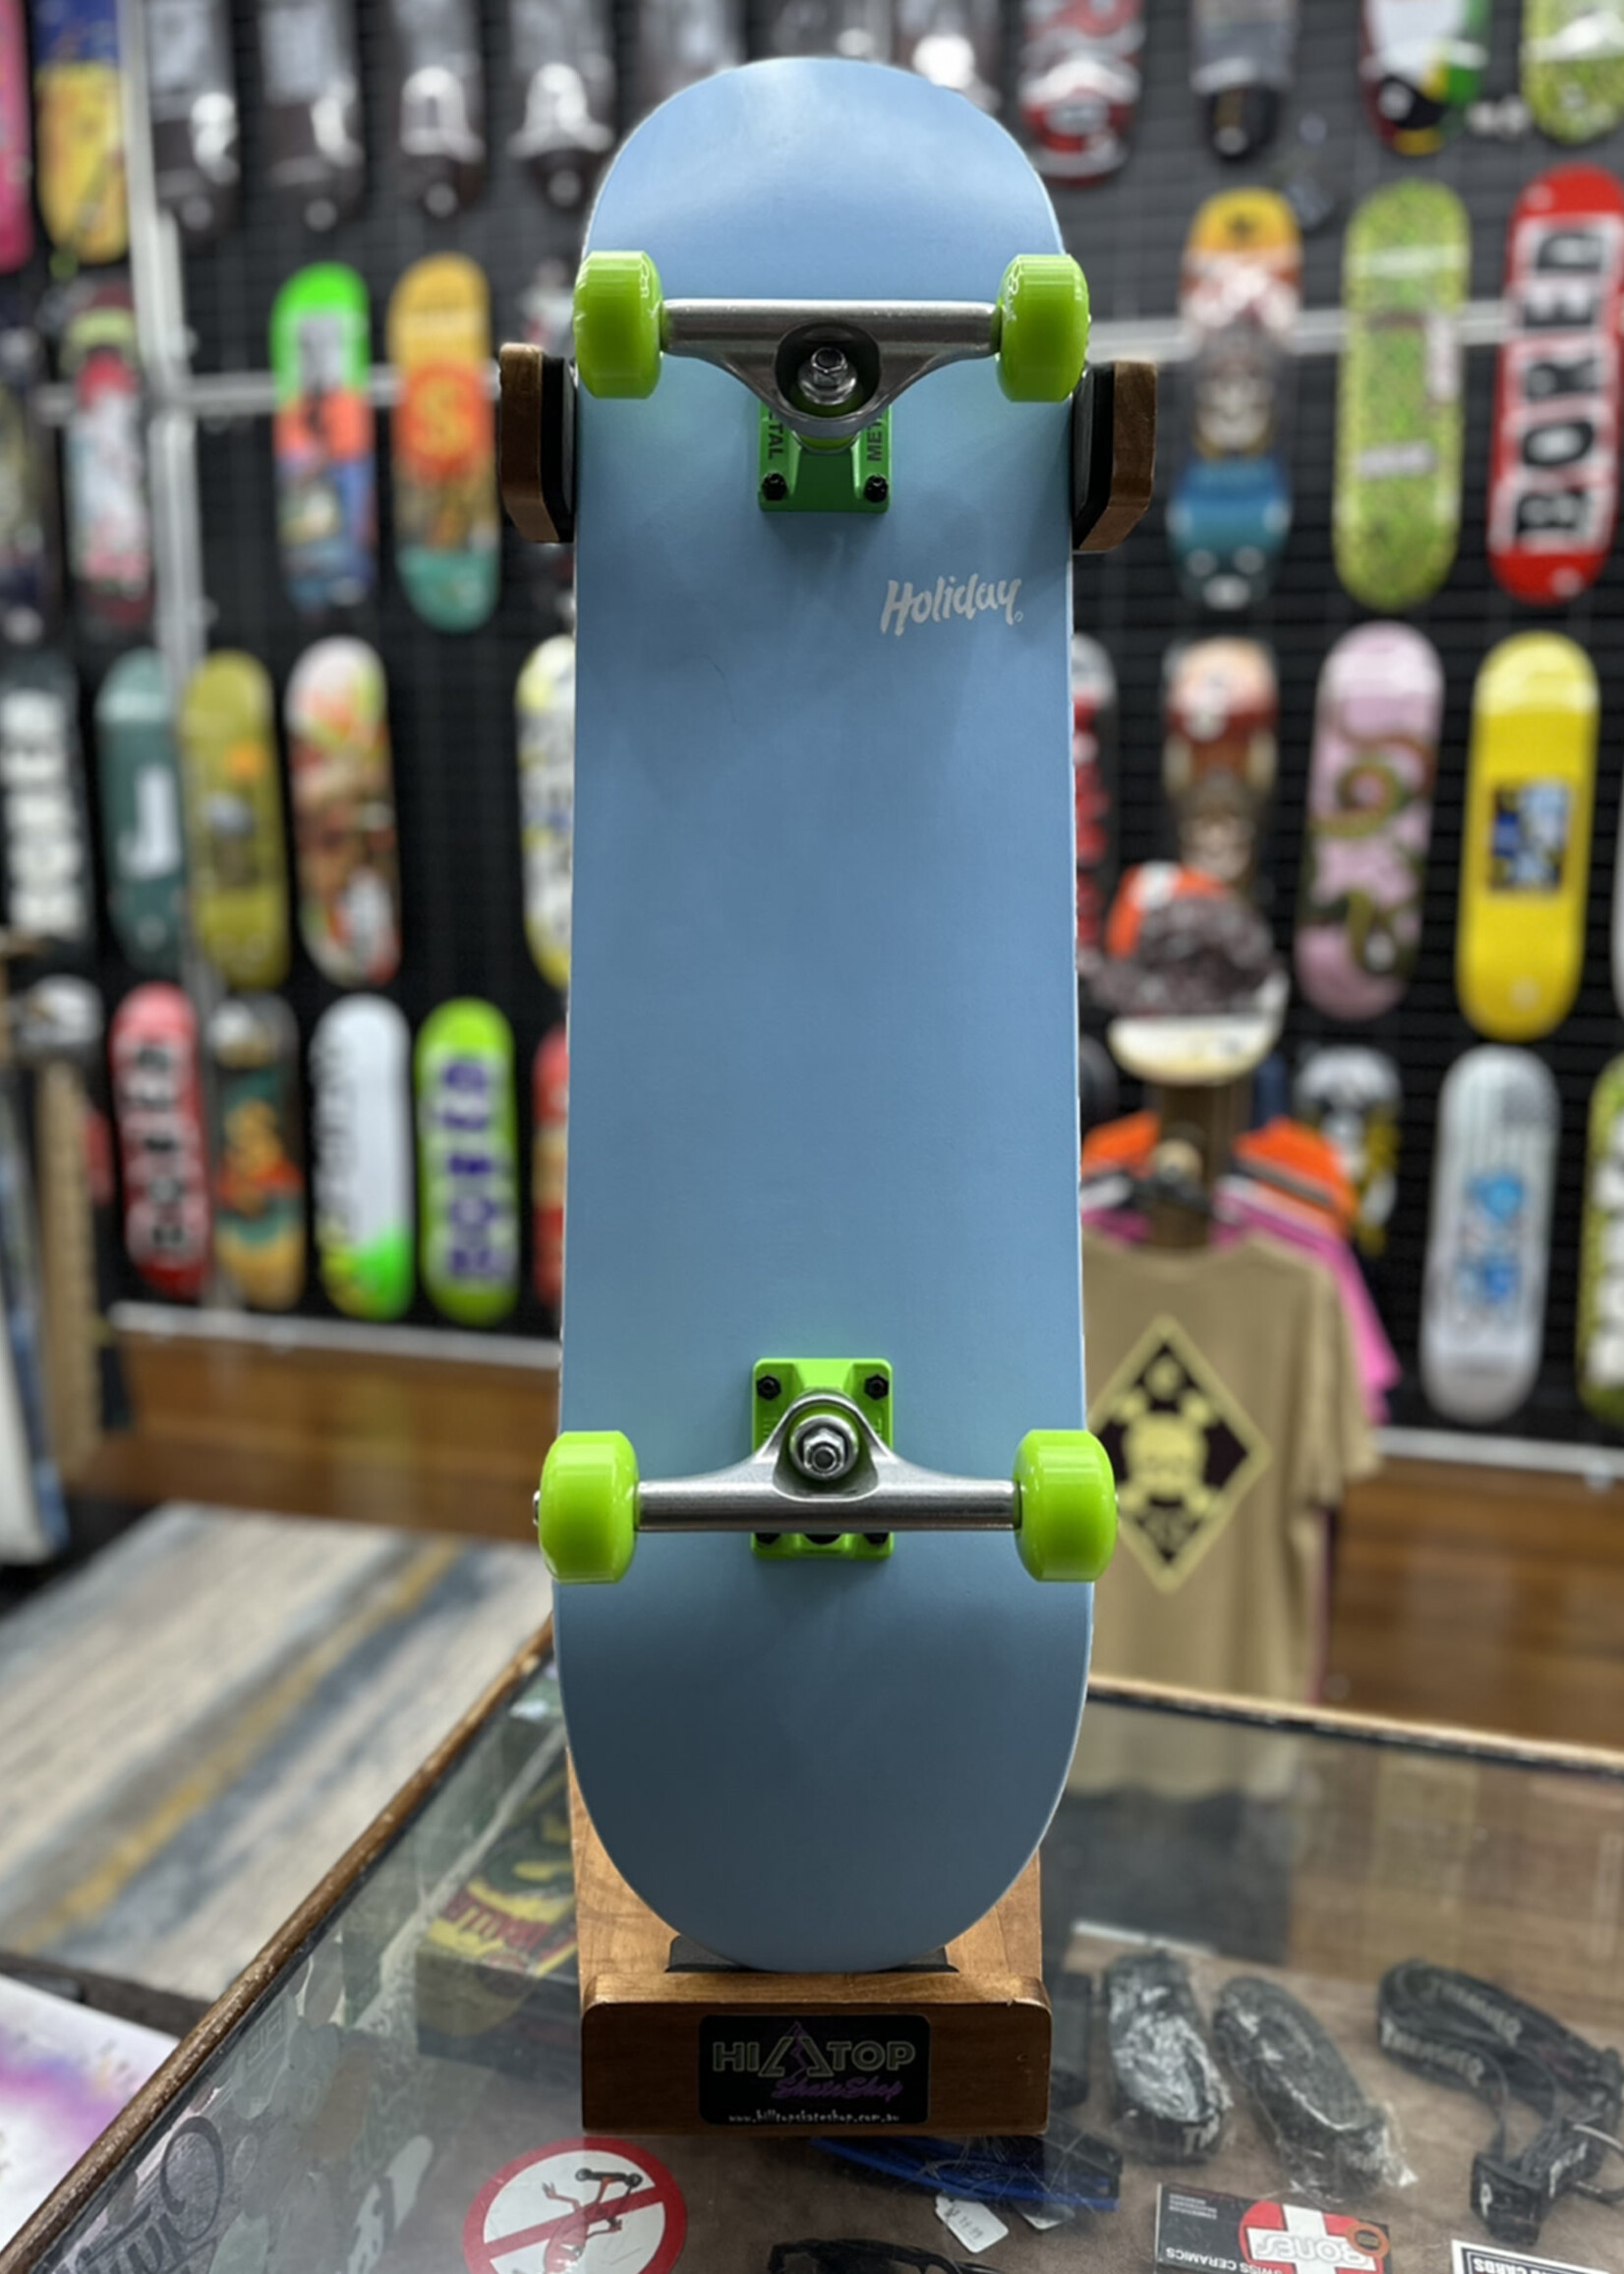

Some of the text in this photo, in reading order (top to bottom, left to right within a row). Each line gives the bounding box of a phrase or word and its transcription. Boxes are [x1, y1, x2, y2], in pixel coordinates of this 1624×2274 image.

[1516, 231, 1602, 536] BORED
[767, 413, 784, 460] TAL
[880, 573, 1022, 636] Holiday
[1166, 2246, 1238, 2270] CERAMICS
